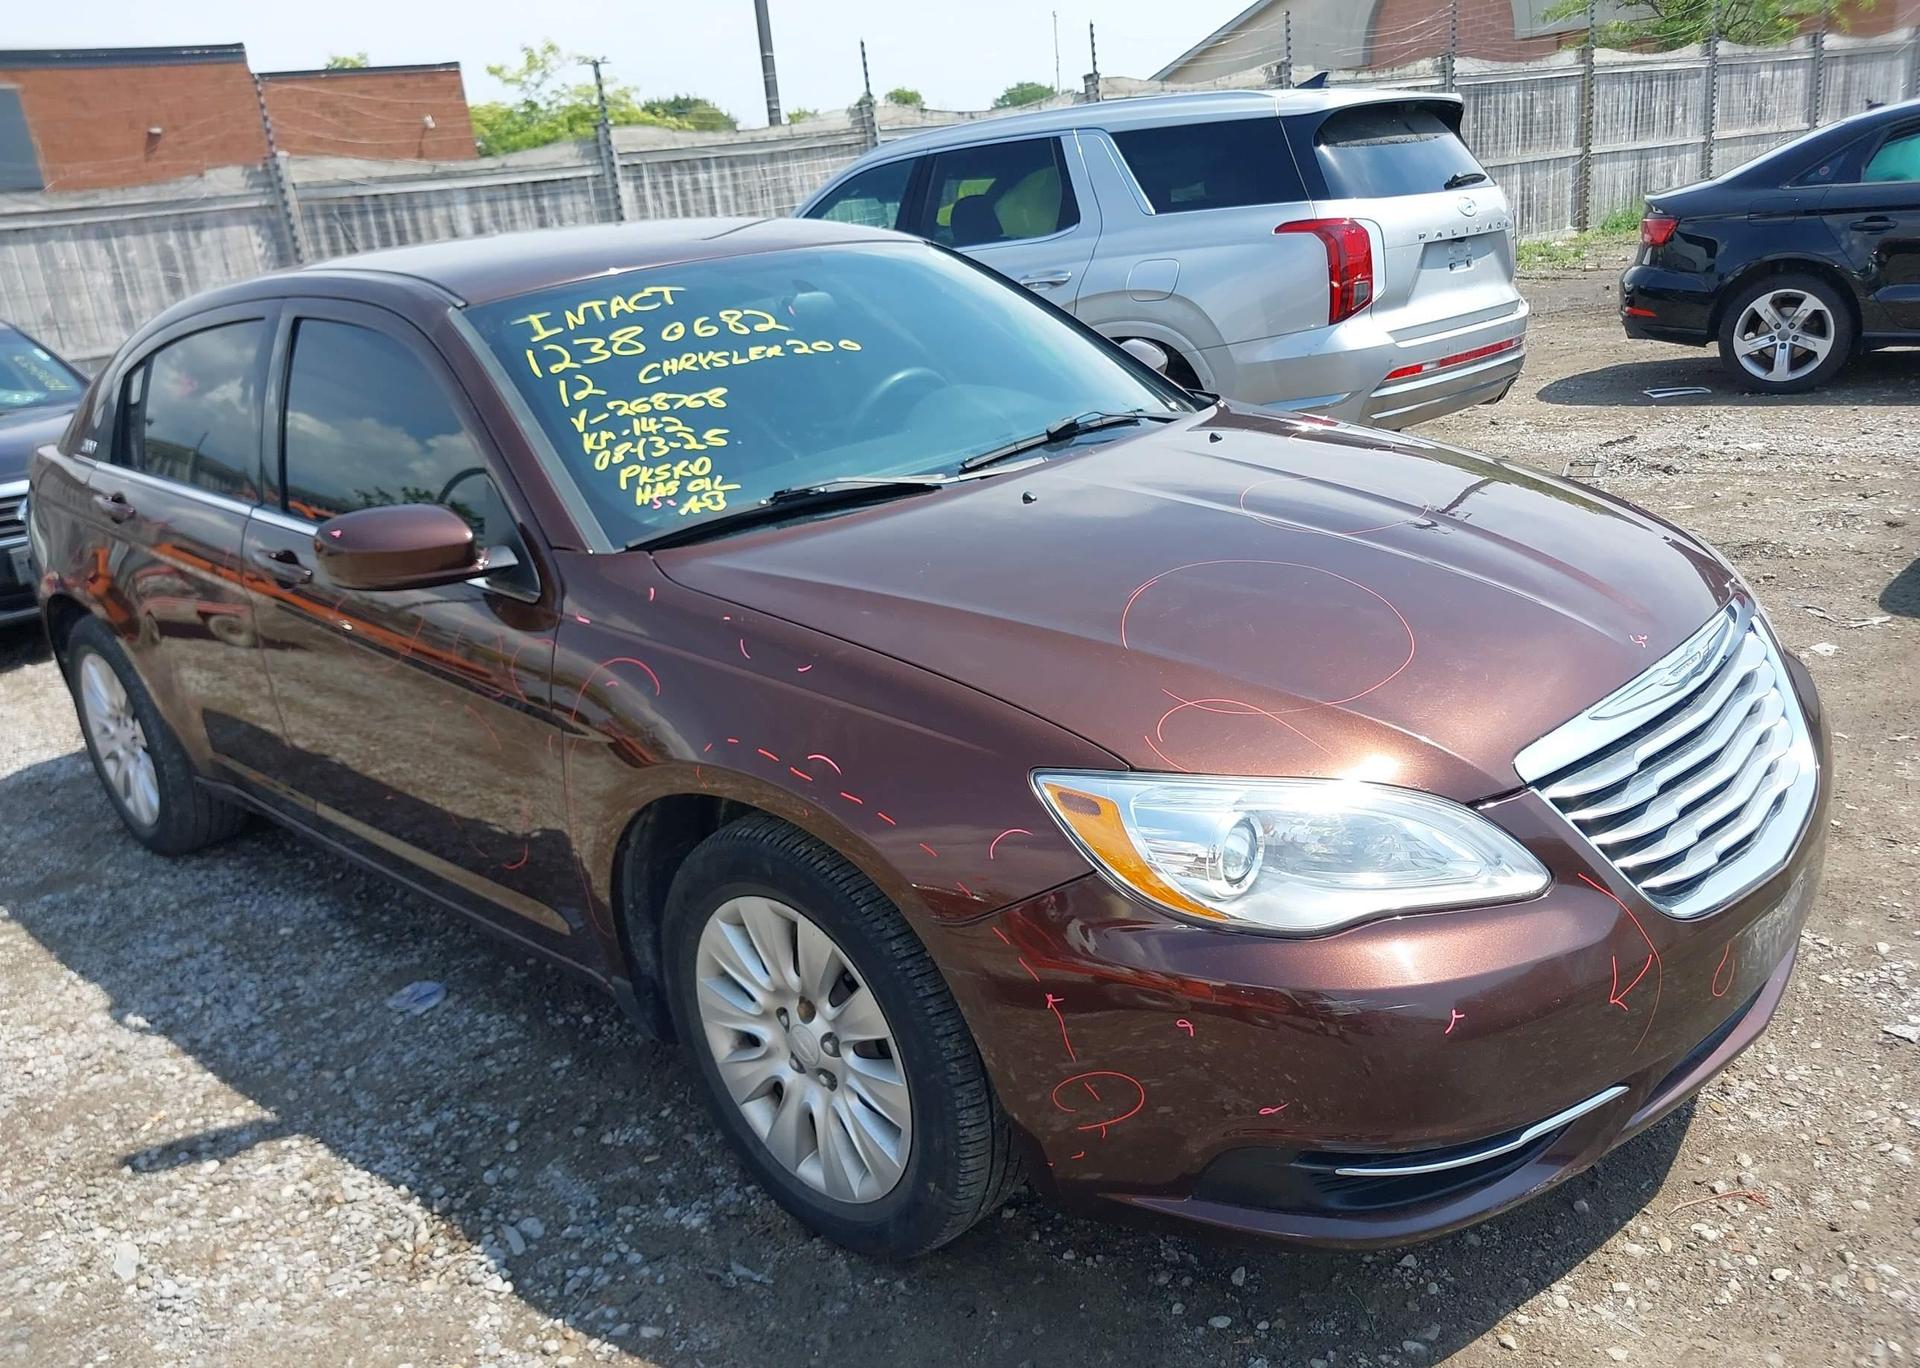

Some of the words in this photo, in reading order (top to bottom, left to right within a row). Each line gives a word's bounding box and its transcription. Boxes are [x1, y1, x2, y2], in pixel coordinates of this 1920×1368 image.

[511, 286, 687, 342] INTACT
[559, 374, 608, 407] 12
[638, 344, 786, 385] CHRYSLER
[785, 339, 863, 355] 200
